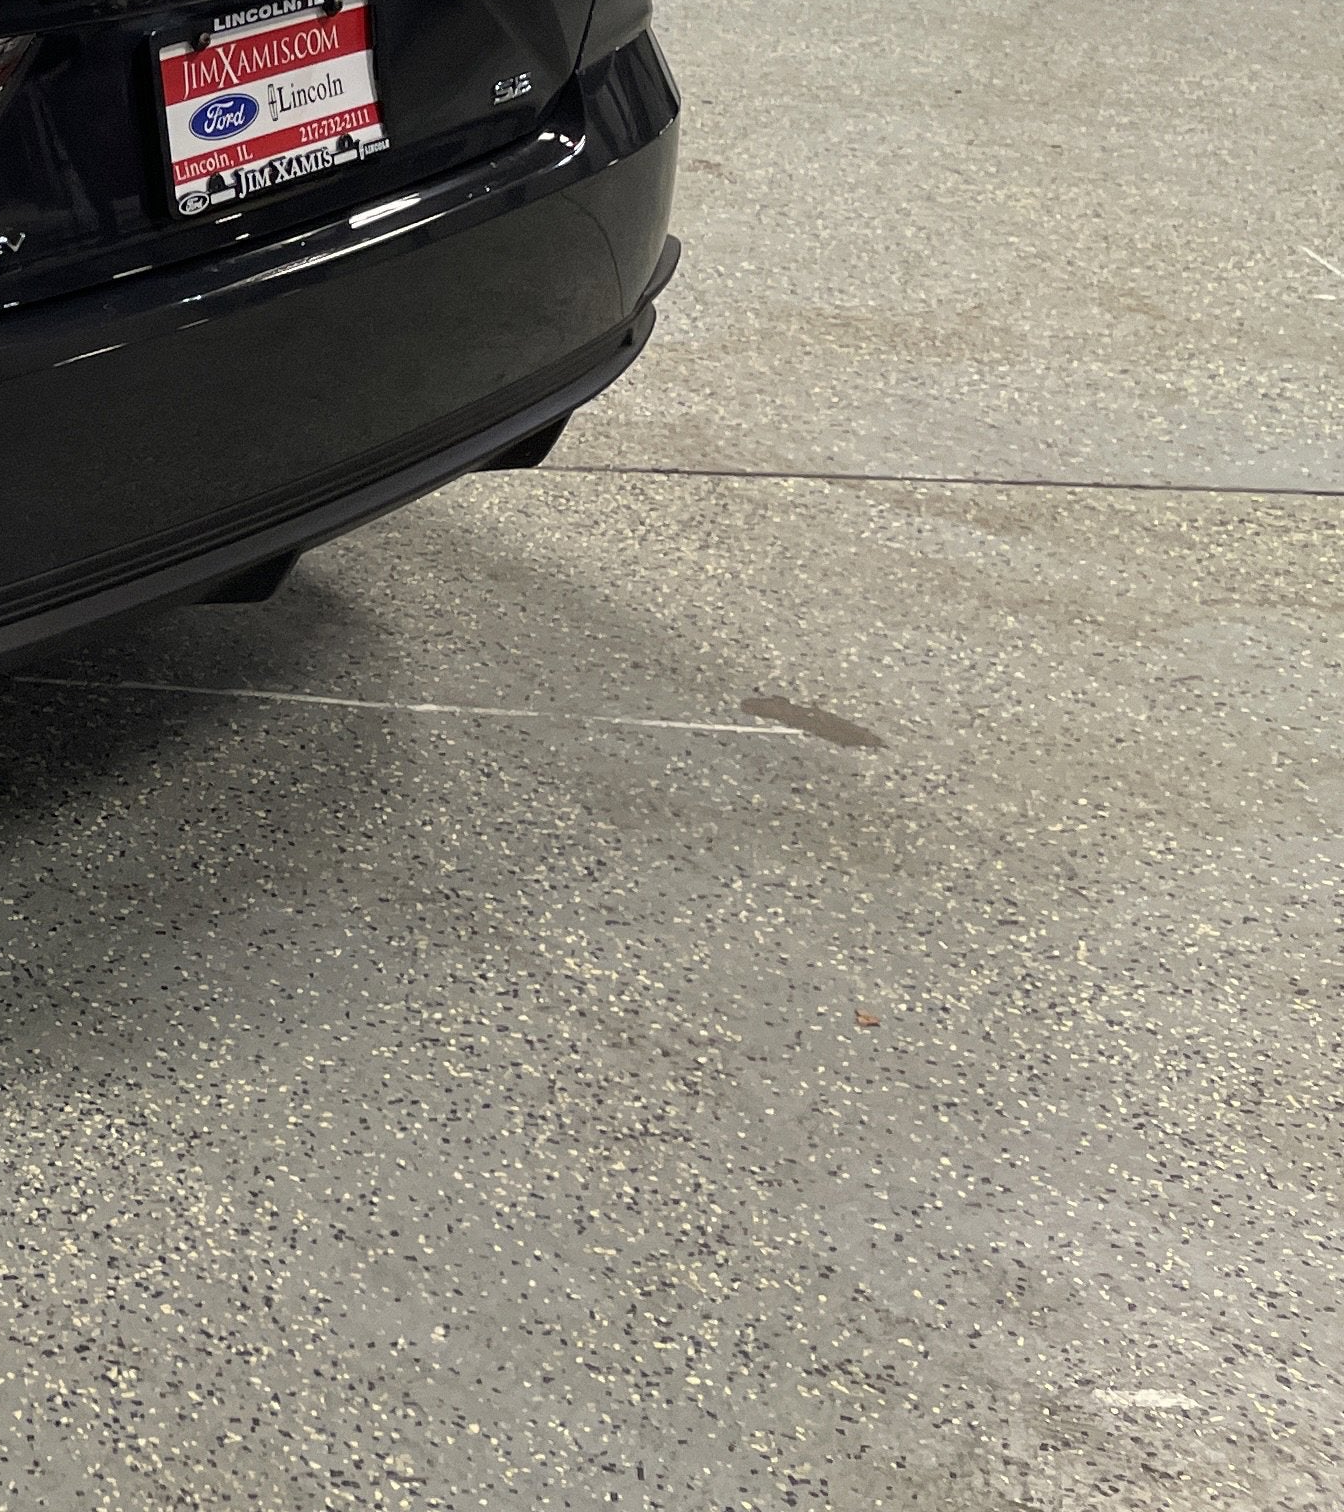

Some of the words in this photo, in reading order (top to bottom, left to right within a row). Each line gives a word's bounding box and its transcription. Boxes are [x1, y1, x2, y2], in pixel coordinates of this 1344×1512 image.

[277, 73, 345, 114] Lincoln
[494, 71, 532, 106] SE
[204, 100, 245, 134] Ford
[299, 108, 370, 144] 217-732-2111
[175, 151, 234, 181] Lincoln,
[236, 144, 254, 162] IL
[238, 169, 271, 199] JIM
[274, 148, 333, 185] XAMIS
